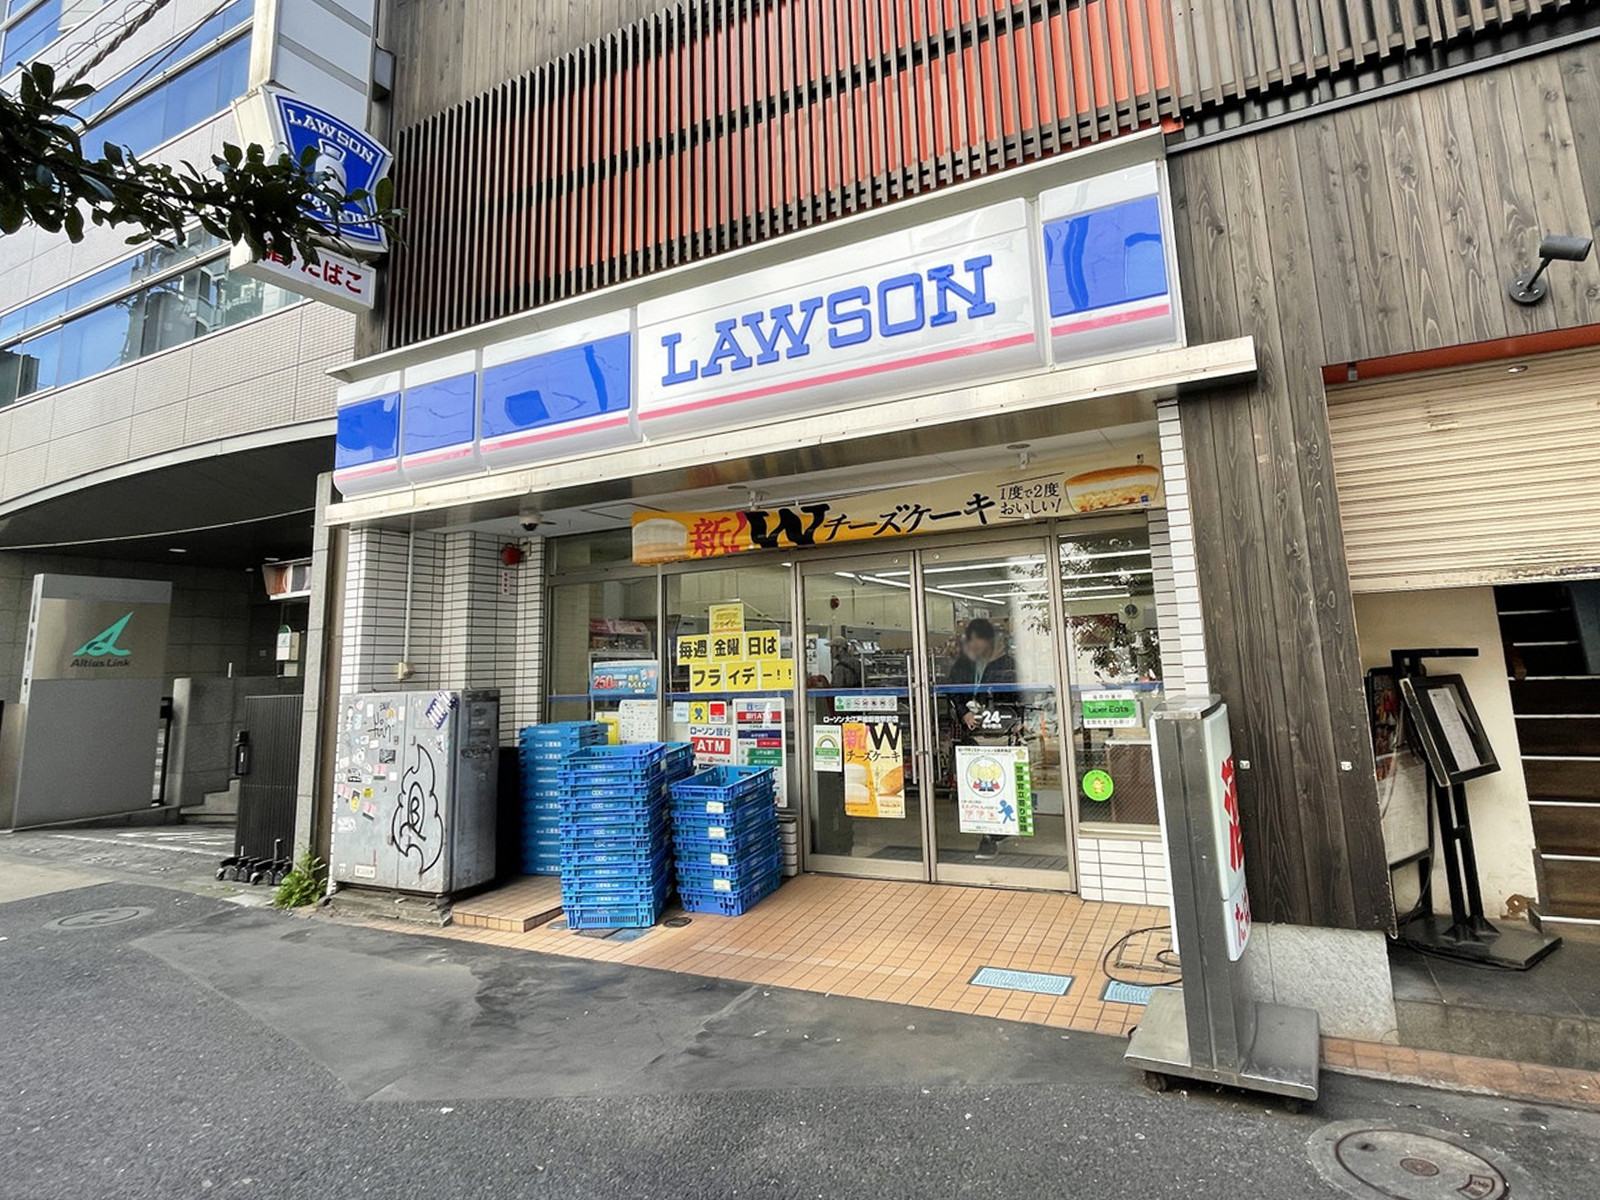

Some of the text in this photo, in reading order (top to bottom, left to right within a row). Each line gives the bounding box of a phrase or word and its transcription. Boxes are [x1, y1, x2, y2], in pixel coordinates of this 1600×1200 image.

[286, 108, 375, 165] LAWSON
[660, 254, 996, 387] LAWSON
[1000, 483, 1060, 500] 1度で2度
[1000, 498, 1062, 515] おいしい!
[70, 659, 130, 667] Altius Link
[1108, 705, 1129, 713] Eats
[982, 710, 1001, 723] 24
[690, 726, 731, 737] ローソン銀行
[696, 739, 726, 752] ATM
[846, 750, 901, 763] チーズケーキ
